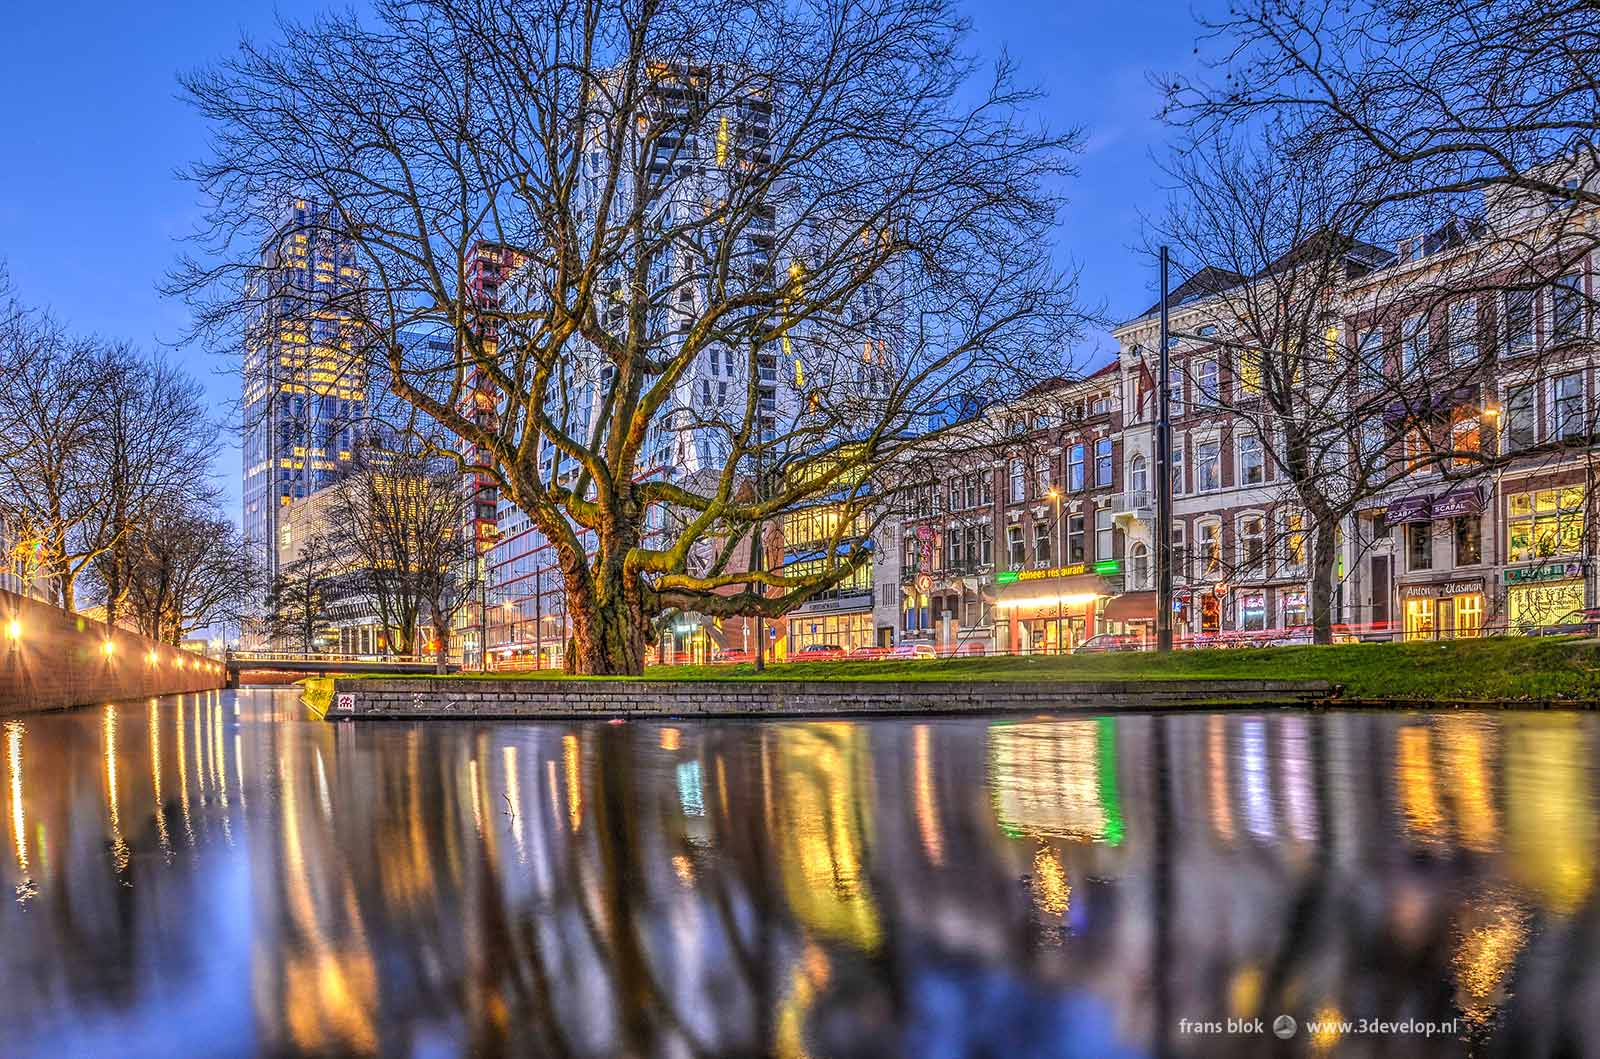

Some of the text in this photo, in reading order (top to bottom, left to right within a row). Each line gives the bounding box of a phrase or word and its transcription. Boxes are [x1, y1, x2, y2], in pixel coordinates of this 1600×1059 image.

[1434, 503, 1466, 512] SCABAL
[1388, 510, 1416, 519] SCABA
[1019, 564, 1085, 580] chinees resaurant
[1407, 586, 1431, 596] Anton
